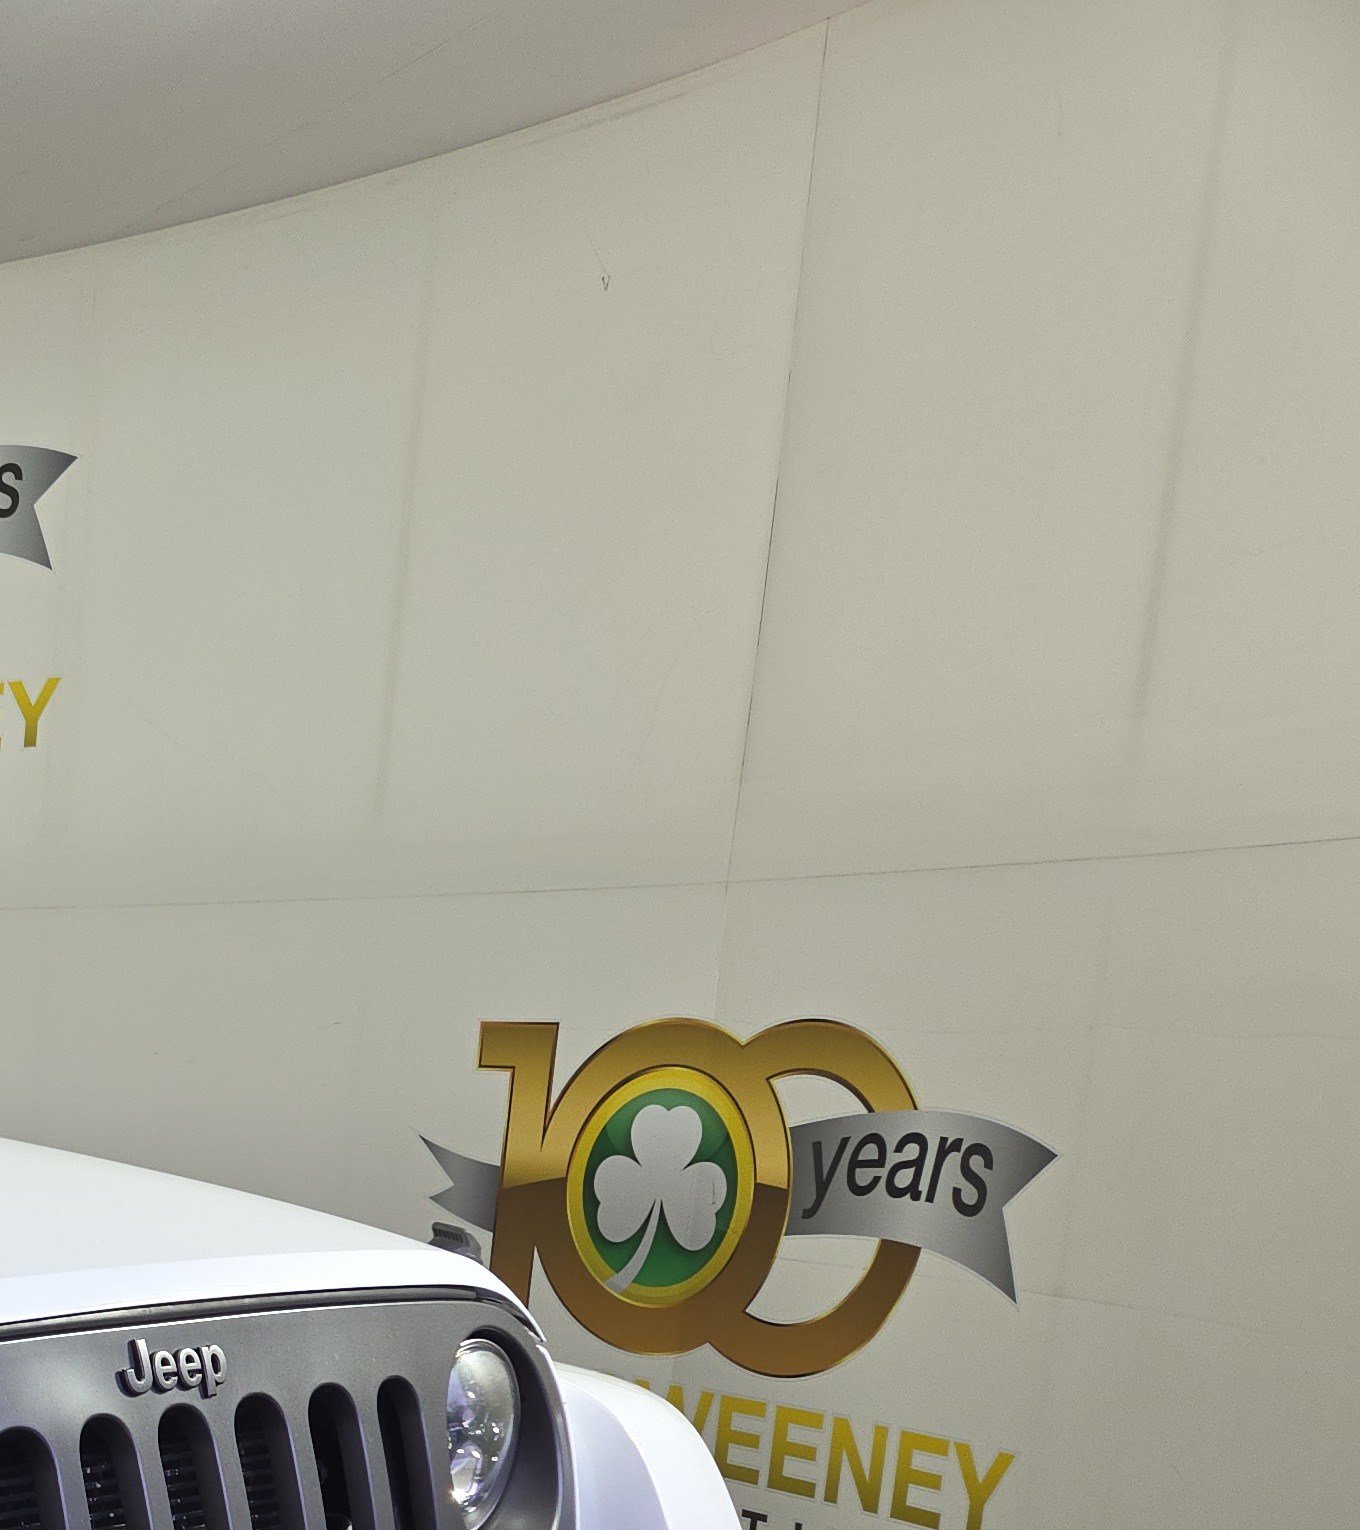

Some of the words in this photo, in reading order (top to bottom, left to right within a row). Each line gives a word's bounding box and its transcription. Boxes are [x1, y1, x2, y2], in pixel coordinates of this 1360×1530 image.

[478, 1017, 922, 1378] 100
[800, 1131, 994, 1218] years
[114, 1338, 228, 1400] Jeep
